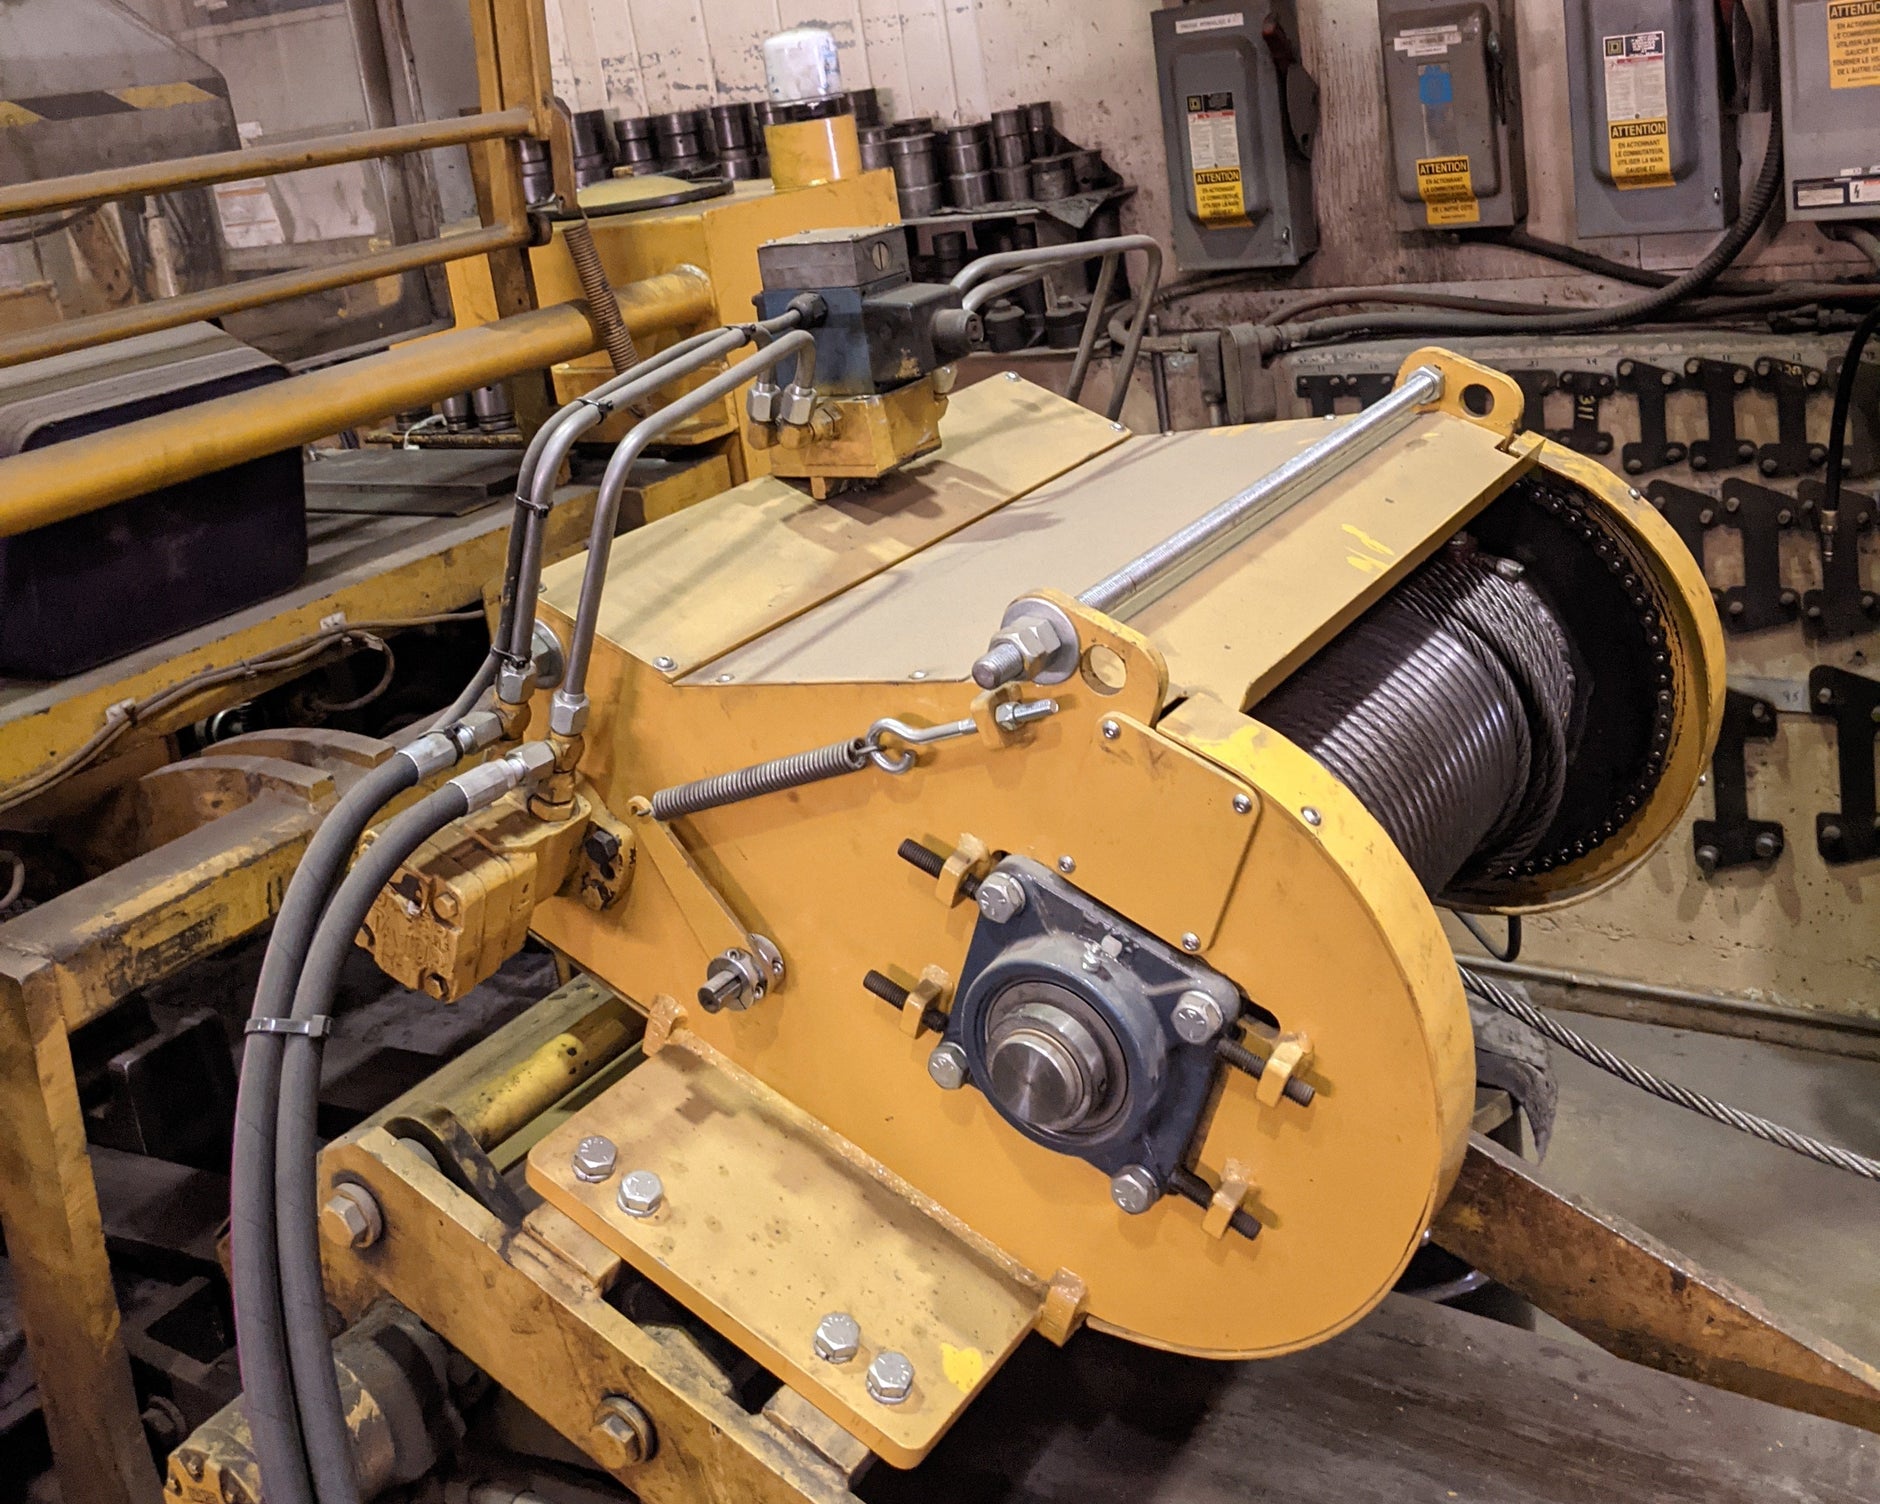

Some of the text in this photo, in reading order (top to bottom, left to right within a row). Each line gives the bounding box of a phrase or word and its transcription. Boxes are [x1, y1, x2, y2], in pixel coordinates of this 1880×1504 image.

[1612, 122, 1665, 138] ATTENTION
[1420, 160, 1467, 175] ATTENTION
[1197, 171, 1239, 184] ATTENTION
